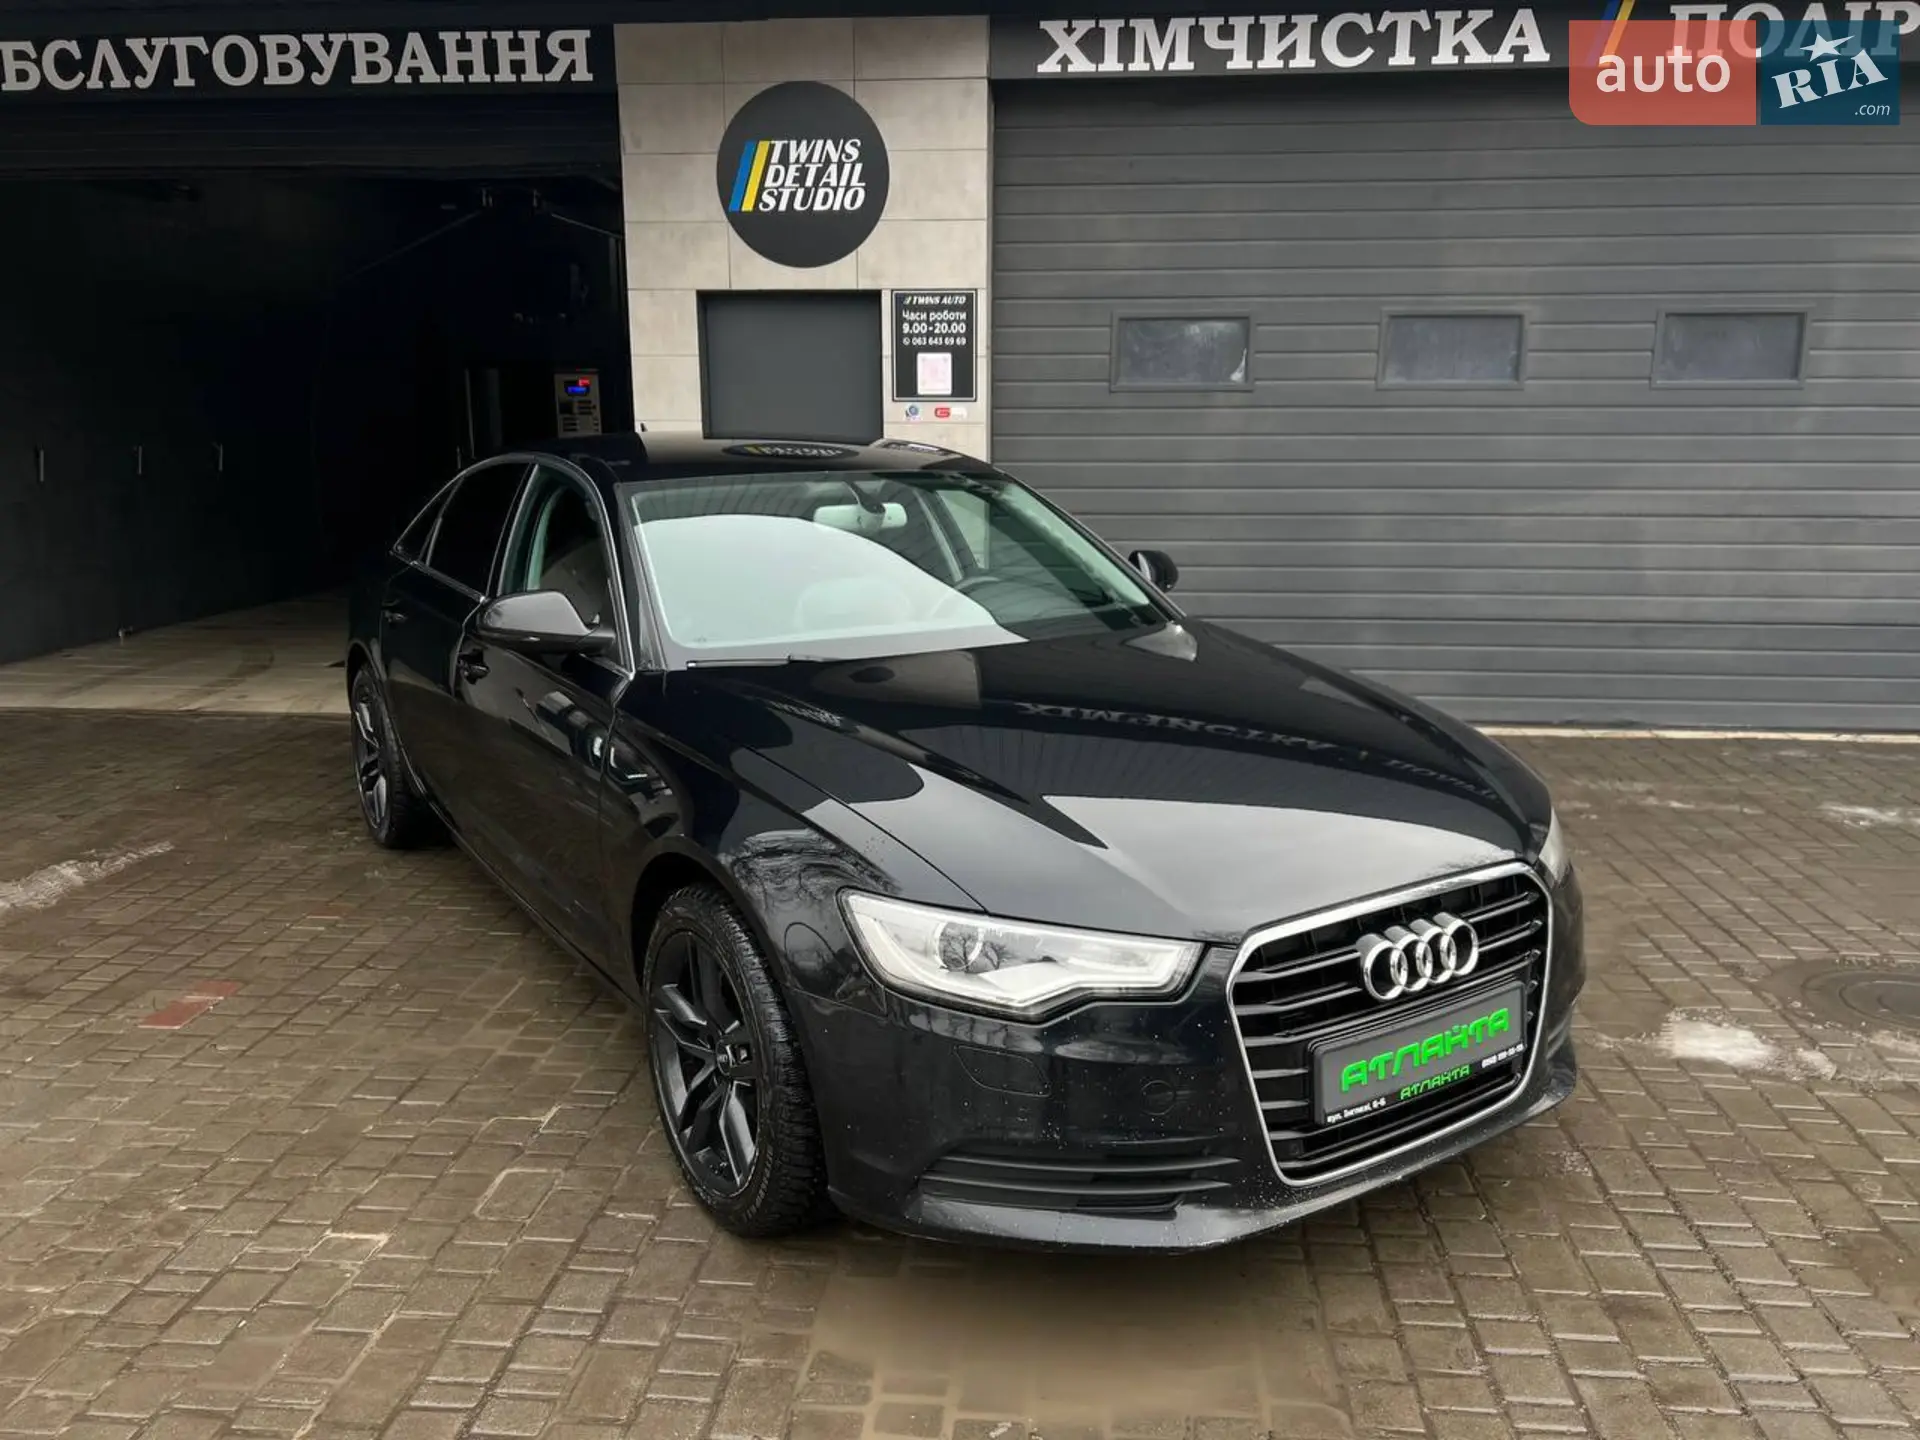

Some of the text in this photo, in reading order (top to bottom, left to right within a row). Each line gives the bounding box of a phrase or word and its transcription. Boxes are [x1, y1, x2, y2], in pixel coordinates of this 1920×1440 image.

[1037, 10, 1550, 74] ХІМЧИСТКА
[0, 30, 594, 92] БСЛУГОВУВАННЯ
[769, 138, 861, 164] TWINS
[764, 163, 866, 188] DETAIL
[758, 187, 866, 212] STUDIO
[941, 295, 967, 305] AUTO
[929, 309, 967, 322] роботи
